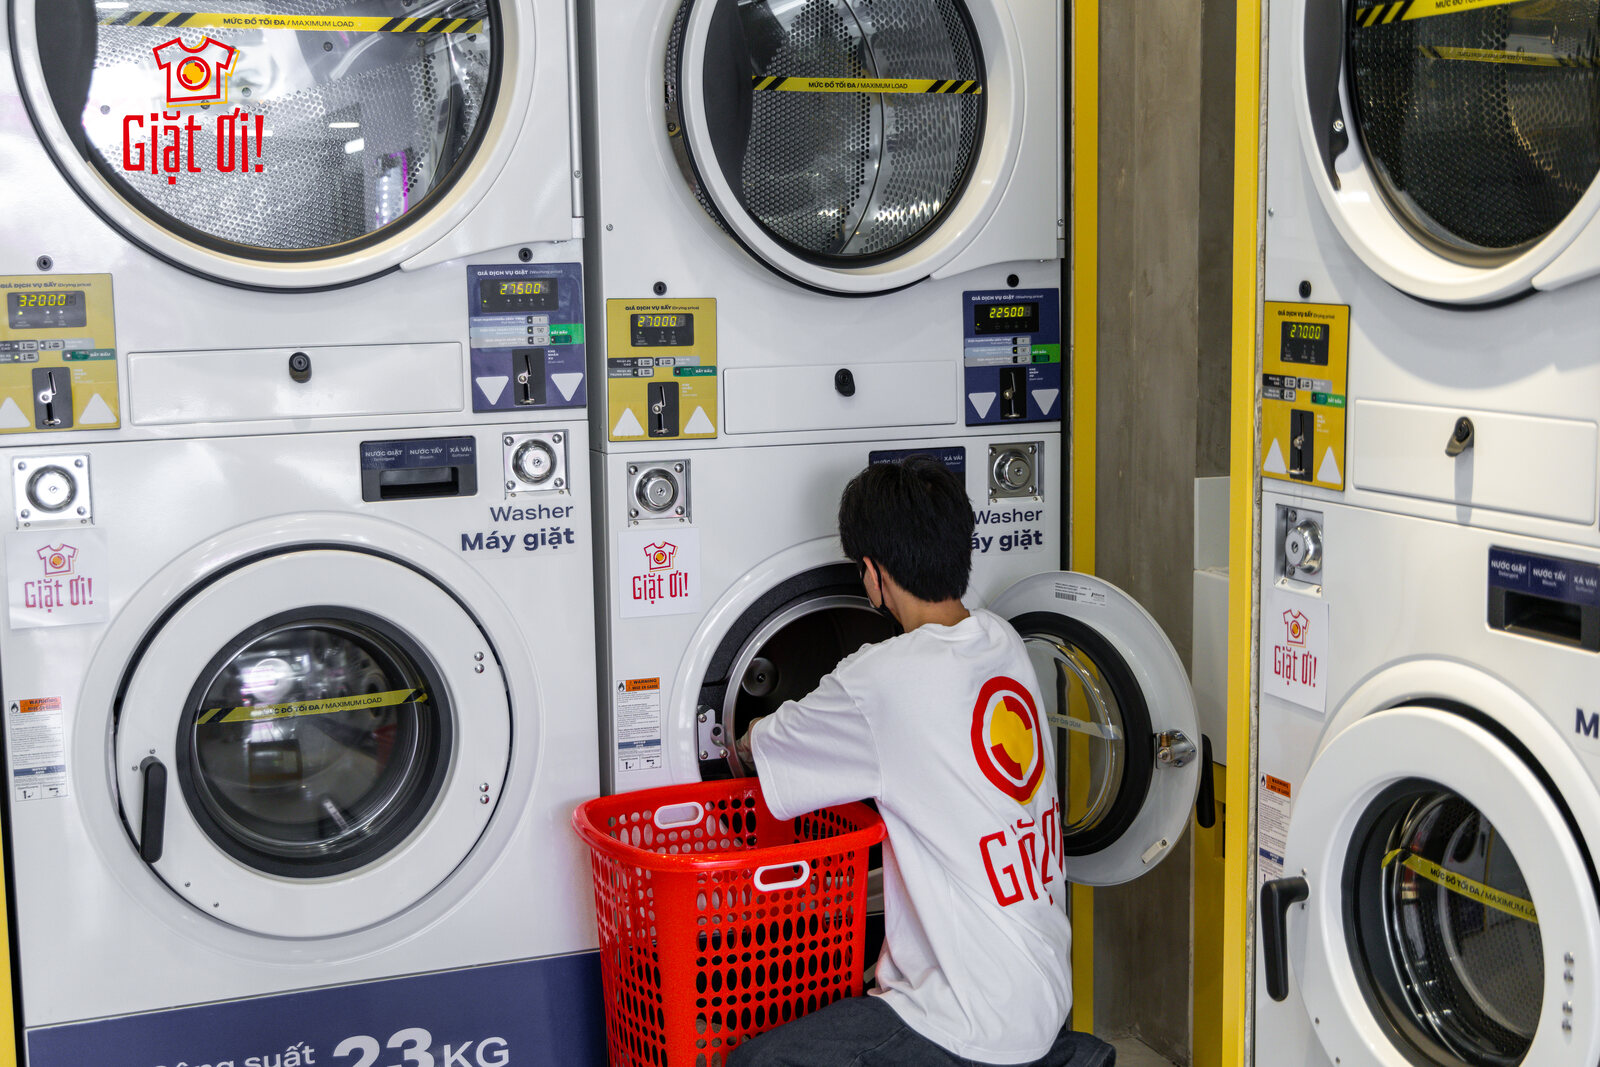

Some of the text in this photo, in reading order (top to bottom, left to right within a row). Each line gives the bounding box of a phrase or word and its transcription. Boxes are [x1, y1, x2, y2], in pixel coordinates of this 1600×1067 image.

[223, 17, 242, 25] MỨC
[500, 283, 541, 295] 27500
[20, 294, 66, 307] 32000
[990, 307, 1024, 318] 22500
[638, 316, 676, 327] 27000
[1290, 324, 1321, 339] 27000
[490, 504, 574, 522] Washer
[973, 508, 1042, 525] Washer
[461, 526, 575, 553] Máy giặt
[971, 529, 1043, 553] áy giặt
[24, 579, 64, 613] Giặt
[633, 573, 664, 604] Giặt
[1274, 645, 1298, 686] Giặt
[325, 700, 362, 709] MAXIMUM
[363, 696, 382, 705] LOAD
[1485, 892, 1524, 913] MAXIMUM
